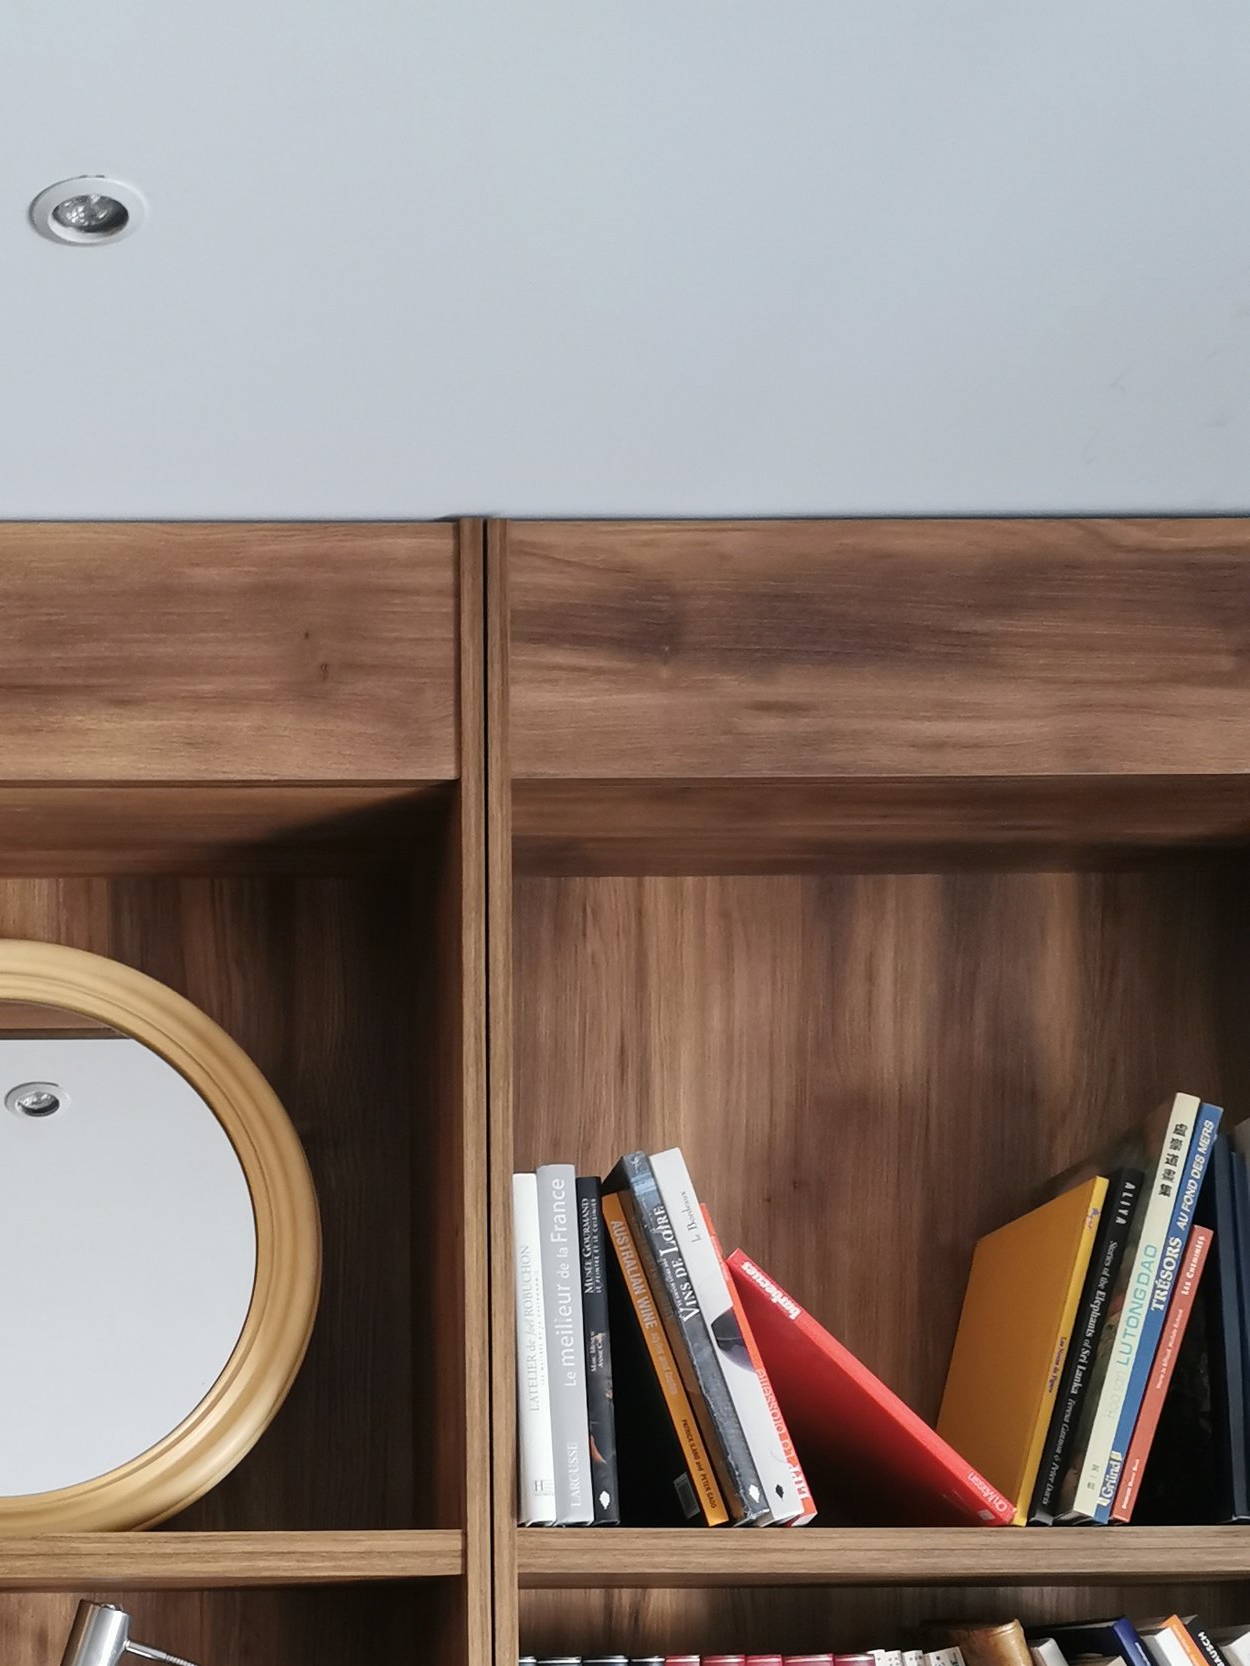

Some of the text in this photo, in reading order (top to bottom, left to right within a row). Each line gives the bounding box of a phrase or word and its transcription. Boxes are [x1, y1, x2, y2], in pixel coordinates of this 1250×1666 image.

[1198, 1119, 1215, 1152] MERS
[1190, 1154, 1205, 1178] DES
[680, 1190, 698, 1232] Bordeaux
[1116, 1182, 1136, 1225] ALIYA
[1181, 1178, 1199, 1211] FOND
[581, 1198, 591, 1258] GOURMAND
[653, 1205, 679, 1257] LOIRE
[1175, 1214, 1190, 1231] AU
[520, 1245, 534, 1318] ROBUCHON
[551, 1178, 577, 1387] Le meilleur de la France
[610, 1220, 657, 1329] AUSTRALIAN WINE
[671, 1255, 687, 1278] DE
[1151, 1236, 1182, 1312] TRÉSORS
[678, 1281, 700, 1323] VINS
[1085, 1288, 1107, 1338] Elephants
[1079, 1347, 1091, 1365] Sri
[1070, 1364, 1087, 1394] Lanka
[567, 1442, 581, 1506] LAROUSSE
[1101, 1460, 1122, 1498] Gründ
